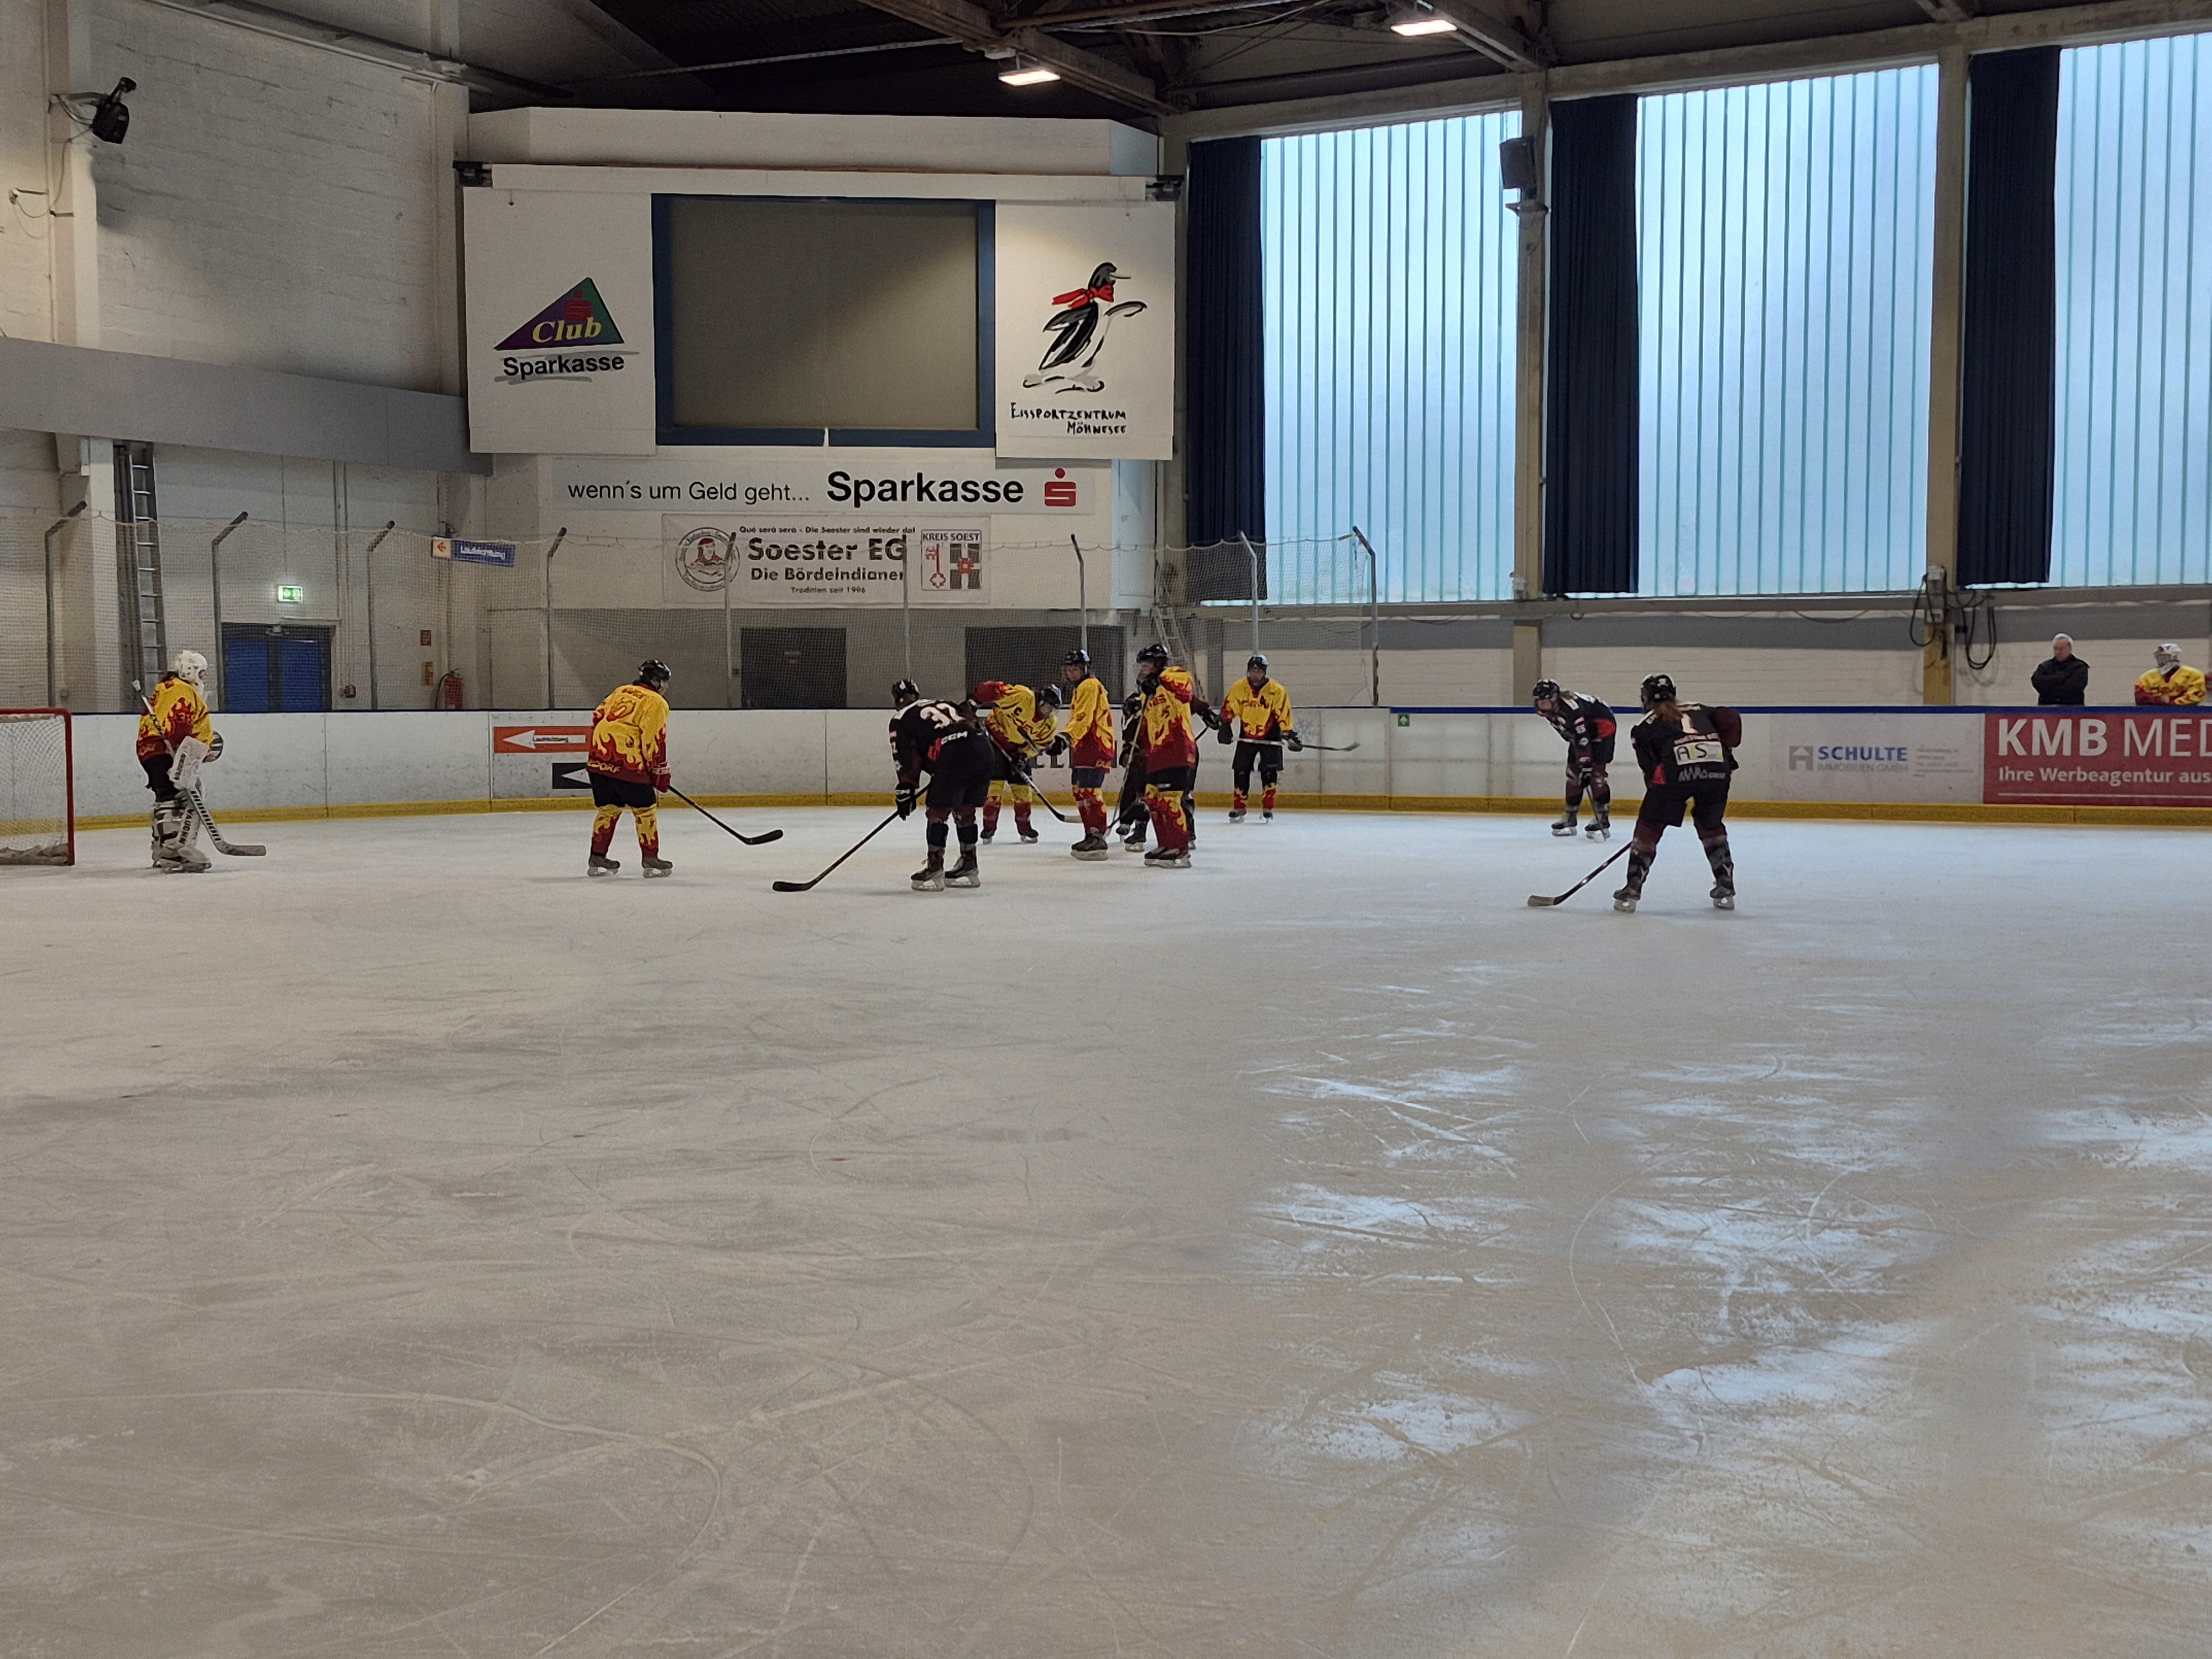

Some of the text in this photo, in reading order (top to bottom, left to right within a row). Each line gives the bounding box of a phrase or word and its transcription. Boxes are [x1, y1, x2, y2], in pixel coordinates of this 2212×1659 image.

[532, 317, 602, 343] Club
[503, 354, 625, 380] Sparkasse
[649, 486, 681, 499] um
[688, 482, 737, 500] Geld
[827, 471, 1024, 508] Sparkasse
[922, 533, 980, 541] KREIS SOEST
[748, 538, 906, 561] Soester EG
[751, 567, 904, 582] Die Bördeindianer
[1998, 718, 2108, 757] KMB
[1818, 746, 1908, 761] SCHULTE
[1999, 766, 2211, 786] Ihre Werbeagentur aus
